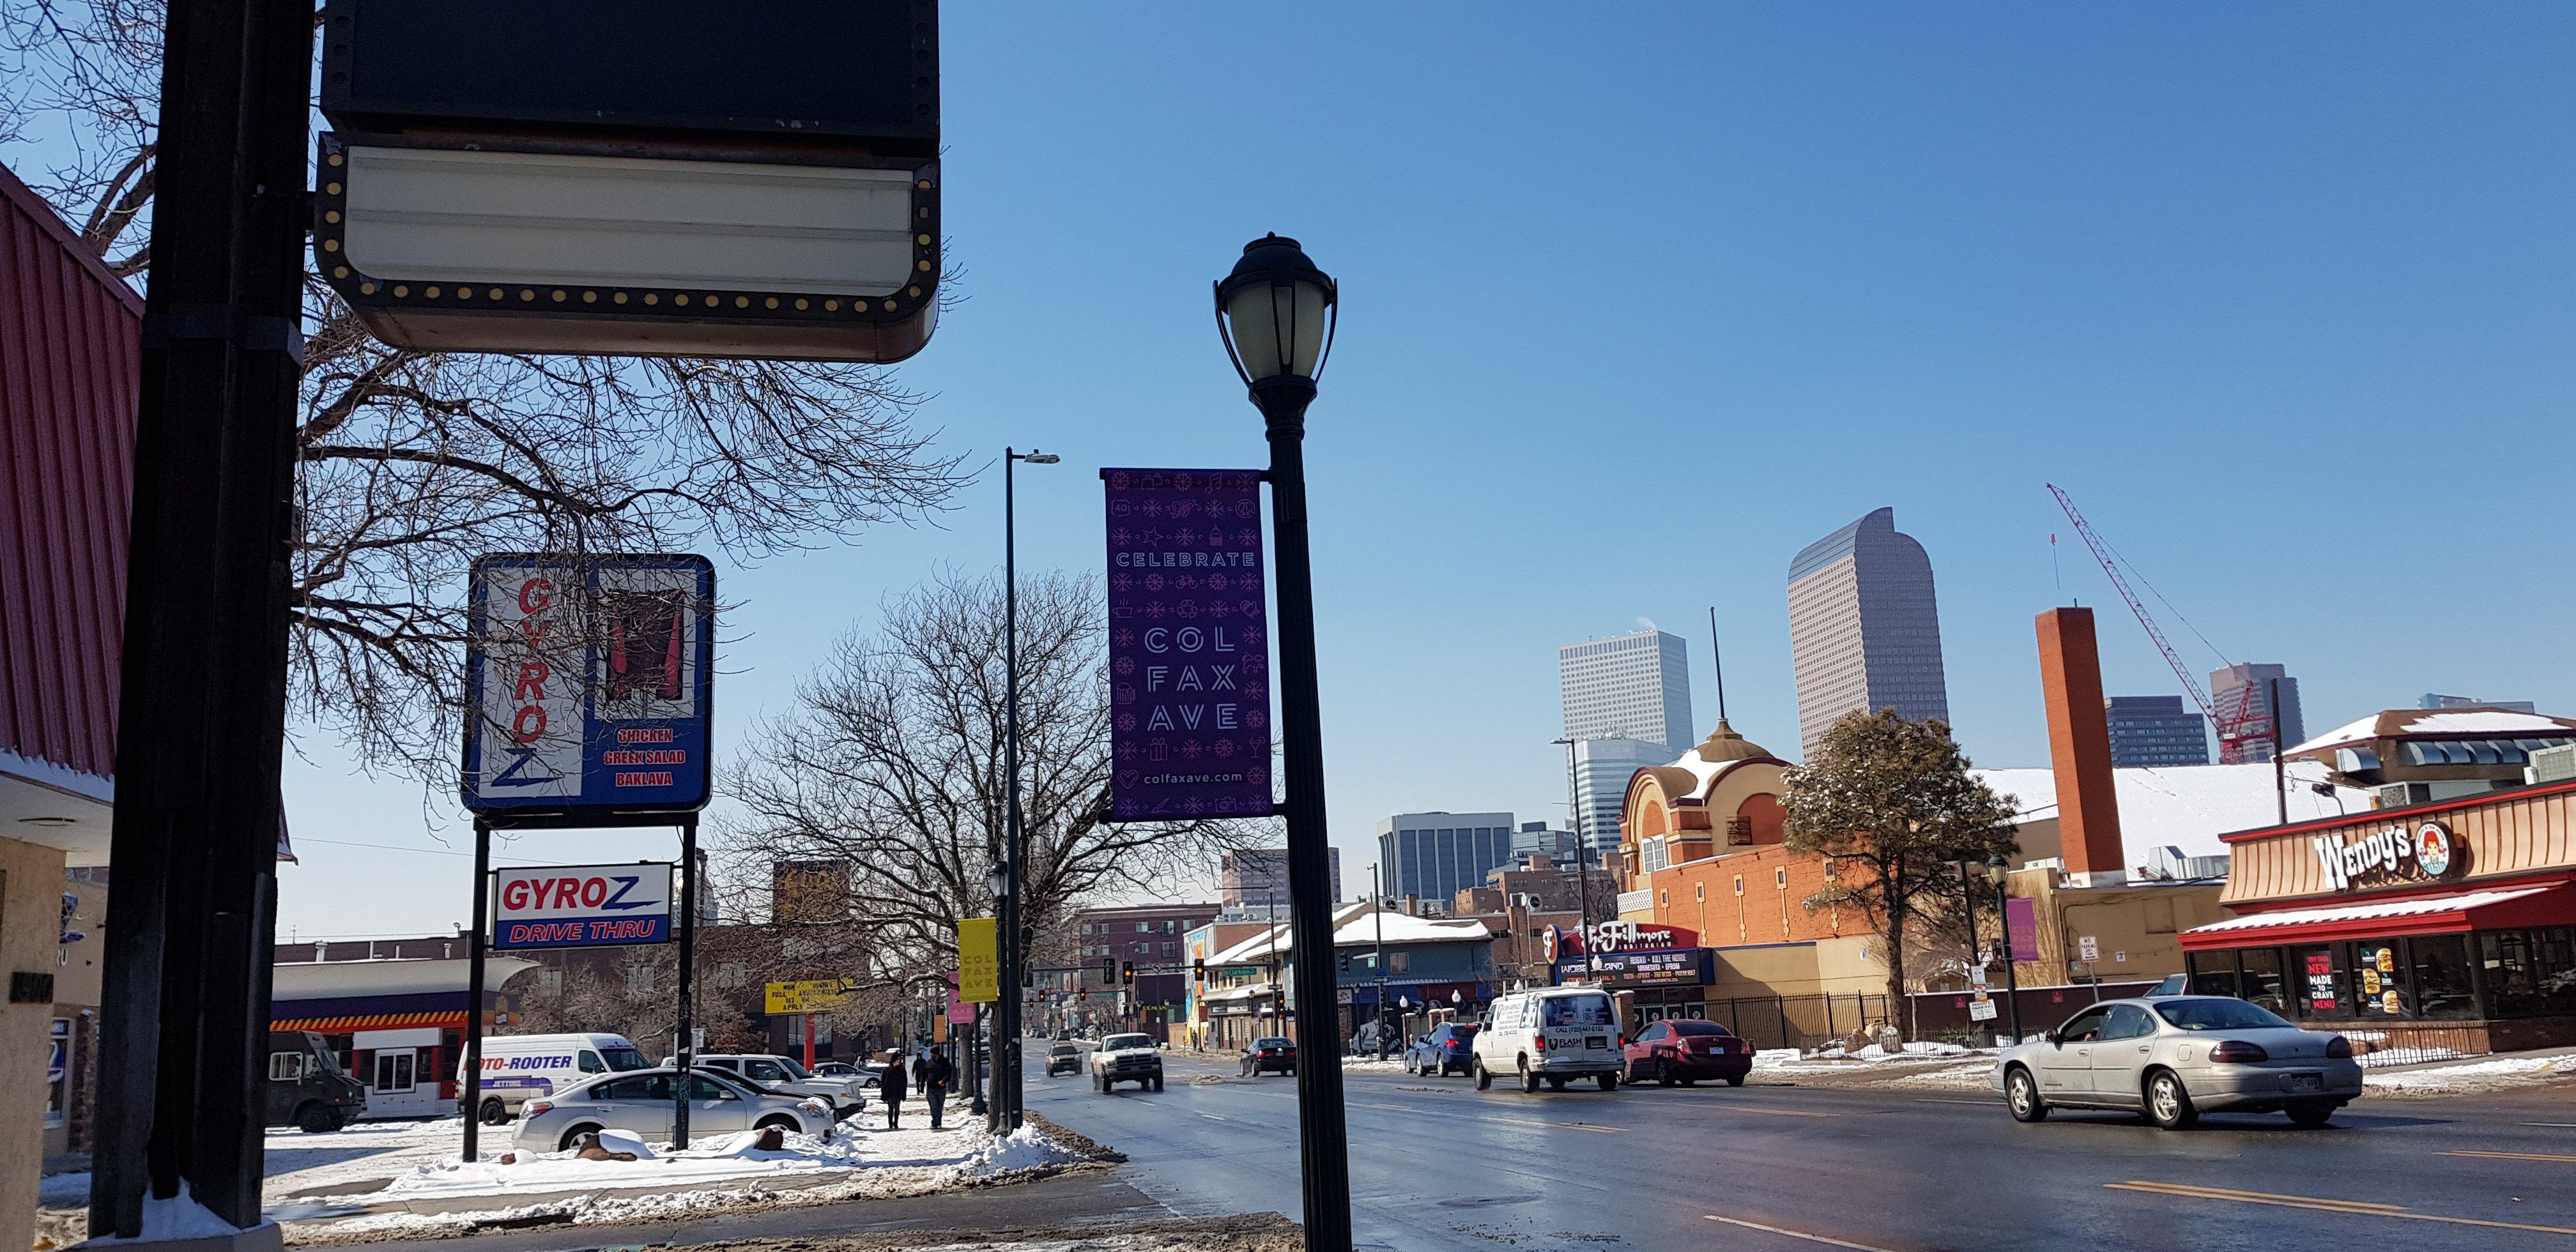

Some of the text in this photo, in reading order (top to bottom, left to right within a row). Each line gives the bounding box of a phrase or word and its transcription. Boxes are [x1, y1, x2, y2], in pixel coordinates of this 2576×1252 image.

[1116, 552, 1255, 567] CELEBRATE
[1144, 627, 1235, 653] COL
[1147, 665, 1236, 692] FAX
[1147, 703, 1238, 731] AVE
[618, 729, 673, 743] CHICKEN
[604, 751, 686, 765] GREEK SALAD
[615, 772, 673, 787] BAKLAVA
[1144, 772, 1243, 785] colfaxave.com
[503, 876, 663, 910] GYROZ
[509, 920, 656, 942] DRIVE THRU
[1598, 919, 1671, 952] Fillmore
[963, 955, 992, 965] COL
[964, 966, 993, 977] FAX
[2308, 964, 2330, 974] NEW
[965, 978, 993, 988] AVE
[2309, 975, 2332, 984] MADE
[2312, 991, 2334, 999] CRAVE
[2313, 1000, 2336, 1009] MENU
[463, 1055, 572, 1070] OTO-ROOTER
